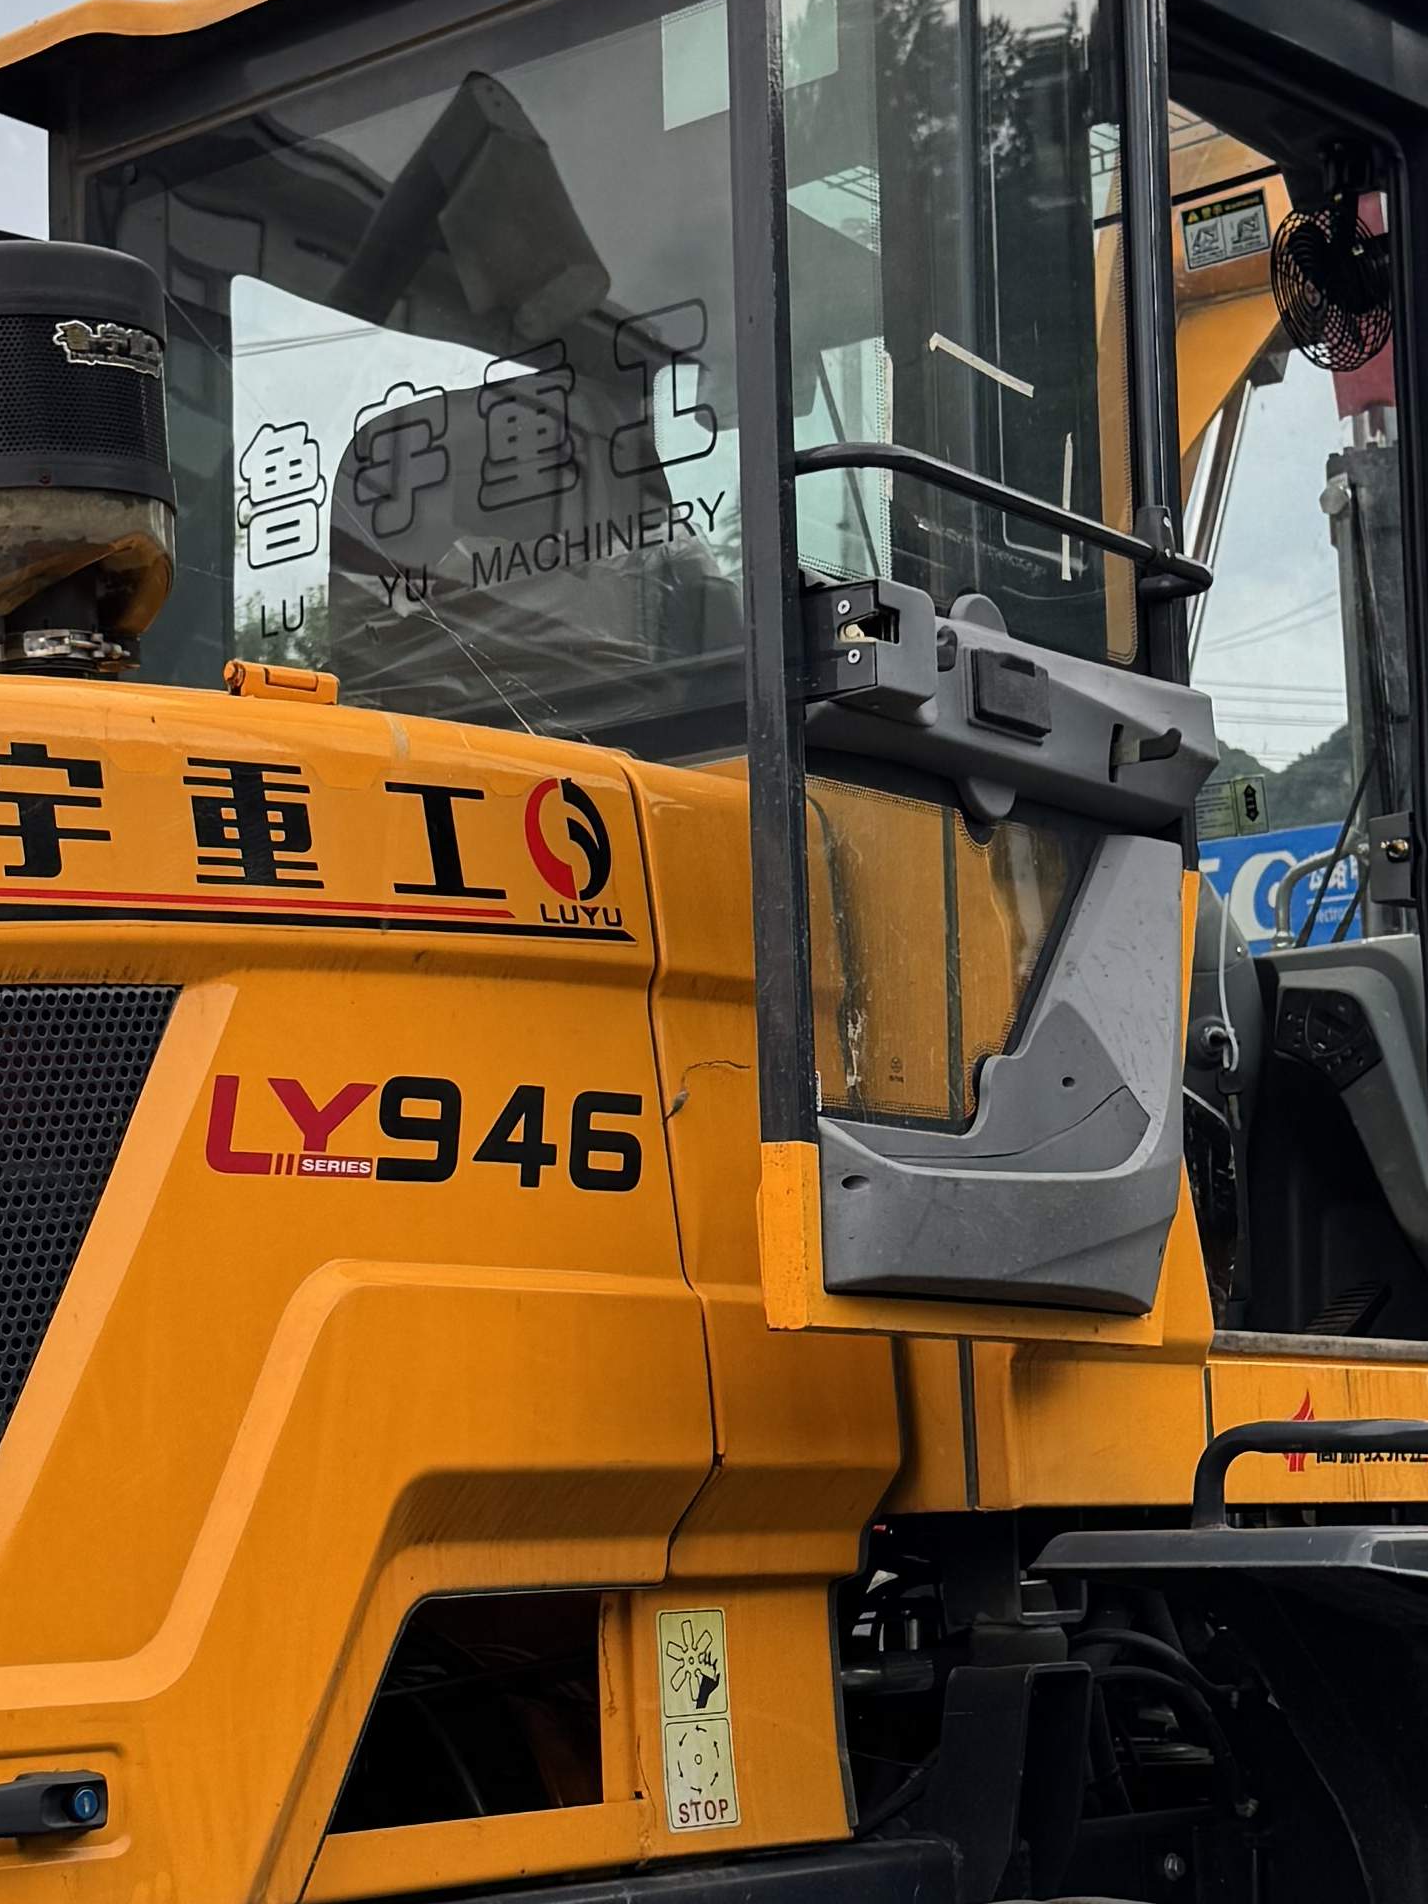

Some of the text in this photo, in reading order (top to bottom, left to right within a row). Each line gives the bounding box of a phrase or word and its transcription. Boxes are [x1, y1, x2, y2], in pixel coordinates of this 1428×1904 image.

[238, 298, 718, 570] 鲁宇重工
[261, 491, 727, 639] LU YU MACHINERY
[540, 902, 623, 927] LUYU
[205, 1075, 643, 1193] LY946
[301, 1157, 372, 1175] SERIES
[679, 1798, 729, 1824] STOP
